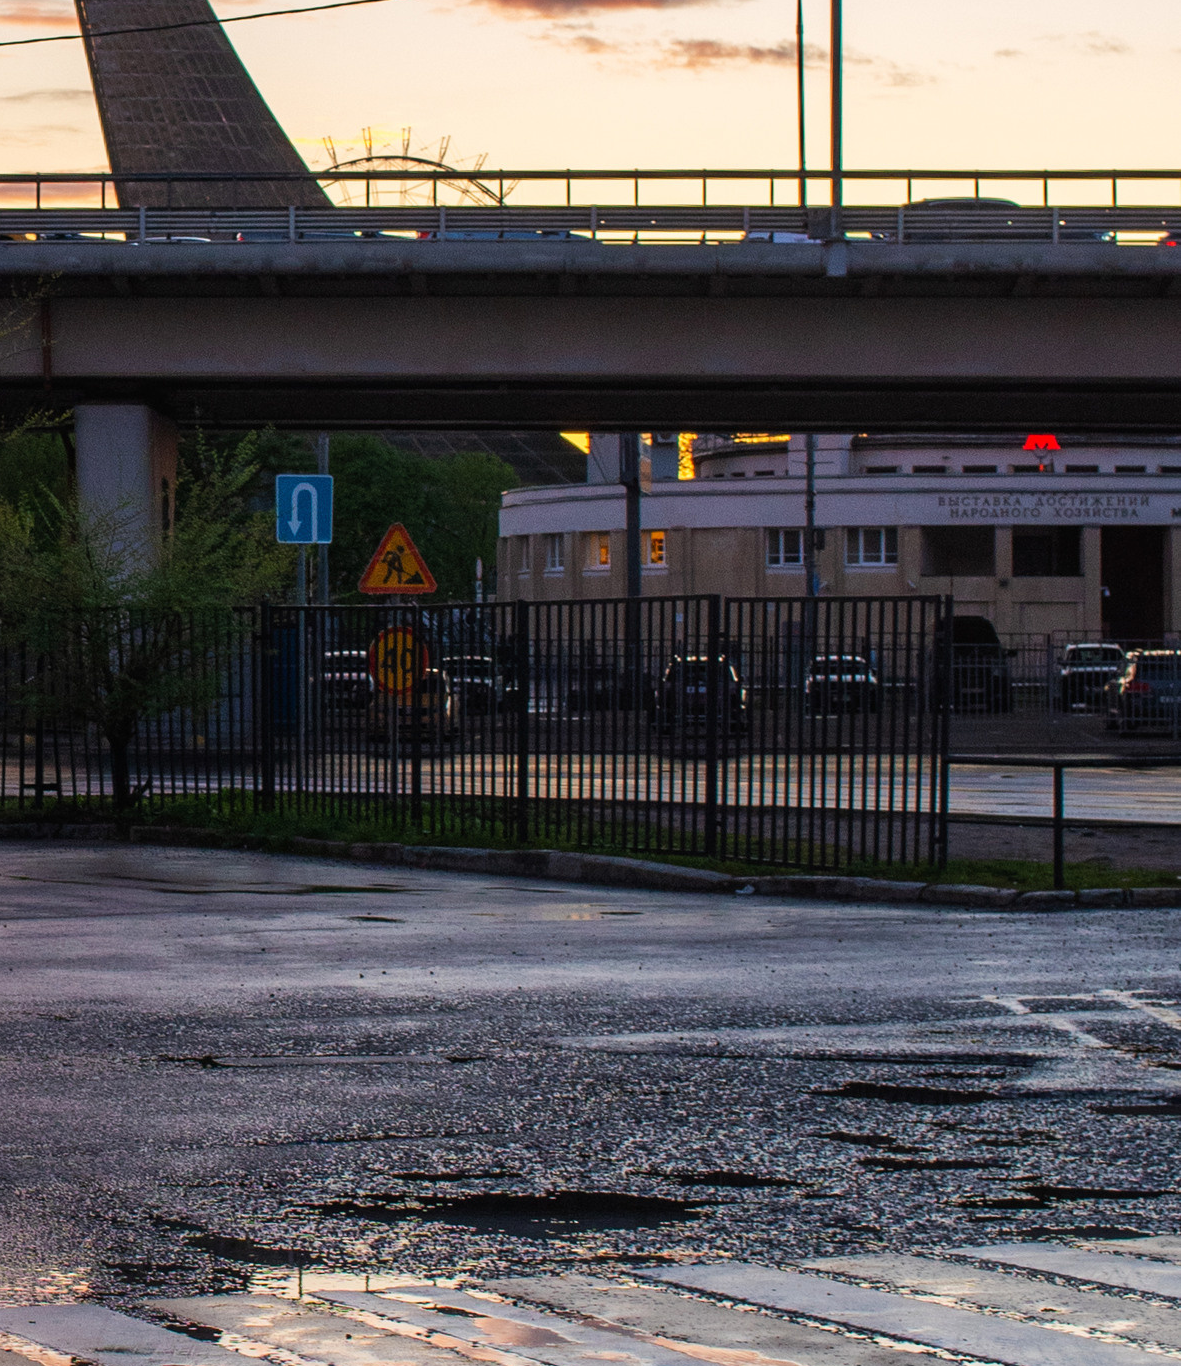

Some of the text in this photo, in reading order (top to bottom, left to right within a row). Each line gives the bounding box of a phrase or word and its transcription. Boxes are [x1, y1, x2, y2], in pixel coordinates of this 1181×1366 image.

[938, 494, 1150, 507] ВЫСТАВКА ДОСТИЖЕНИЙ
[950, 507, 1041, 519] НАРОДНОГО
